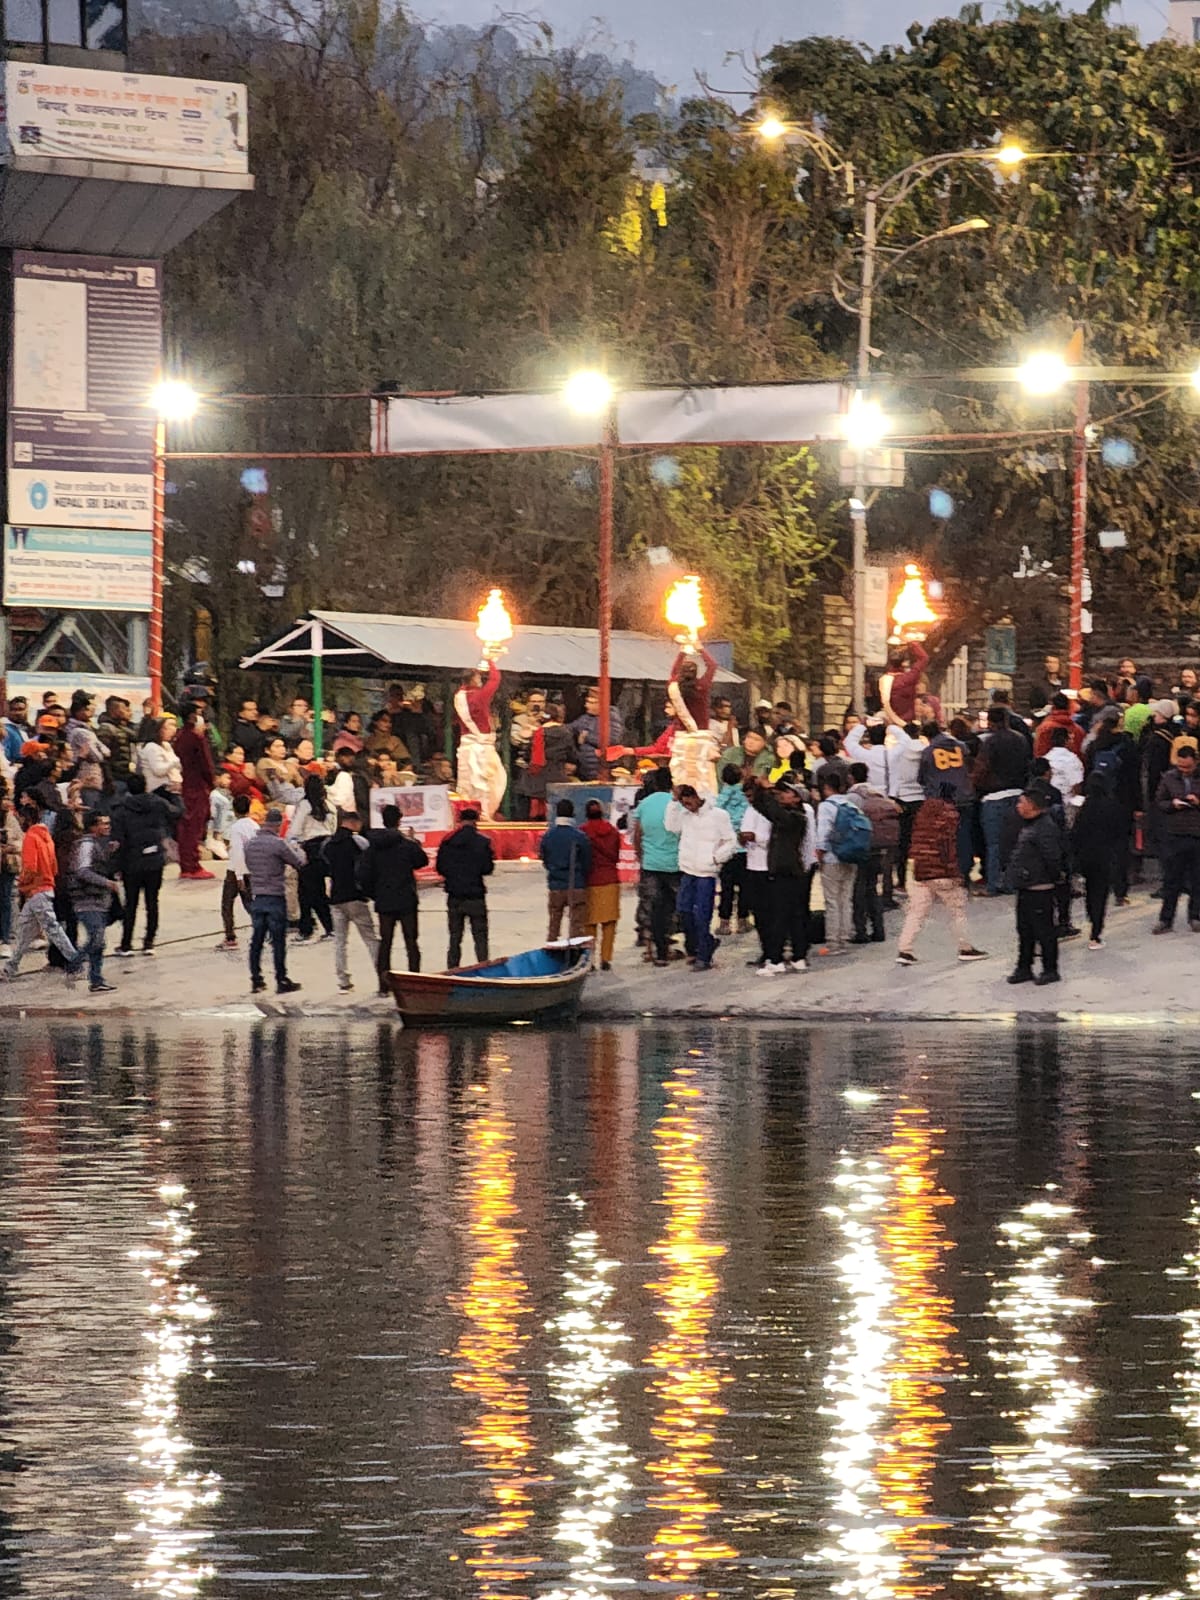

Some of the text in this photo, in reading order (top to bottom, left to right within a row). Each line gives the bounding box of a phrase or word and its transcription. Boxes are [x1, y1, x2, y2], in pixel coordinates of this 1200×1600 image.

[54, 497, 83, 508] NEPAL
[86, 498, 100, 509] SBI
[103, 499, 129, 510] BANK
